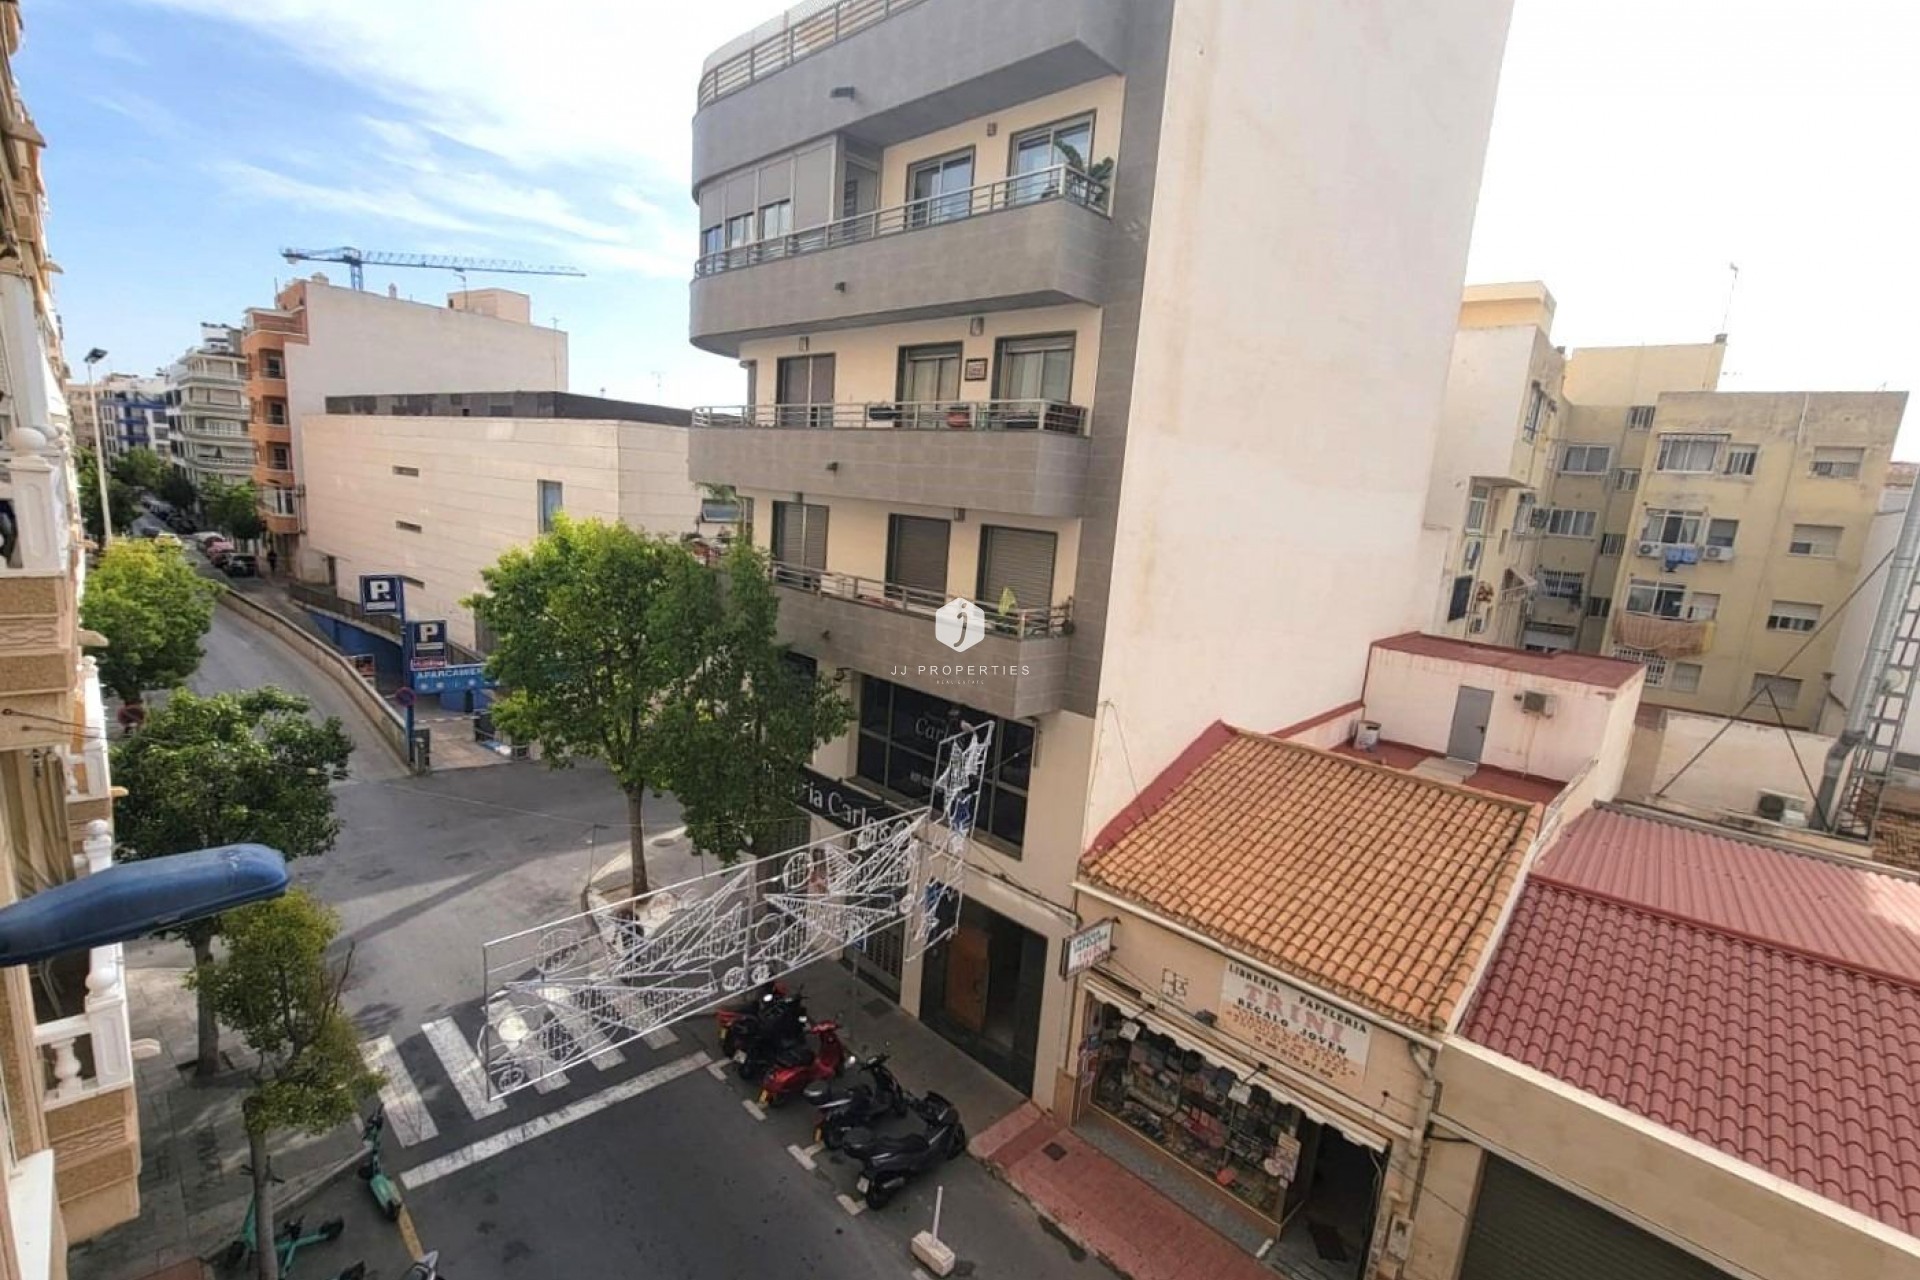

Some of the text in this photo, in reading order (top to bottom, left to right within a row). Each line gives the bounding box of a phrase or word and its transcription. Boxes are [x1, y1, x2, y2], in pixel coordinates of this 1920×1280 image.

[369, 580, 390, 600] P
[419, 623, 439, 642] P
[1238, 997, 1347, 1054] REGALO JOVEN
[1244, 984, 1343, 1043] TRINI
